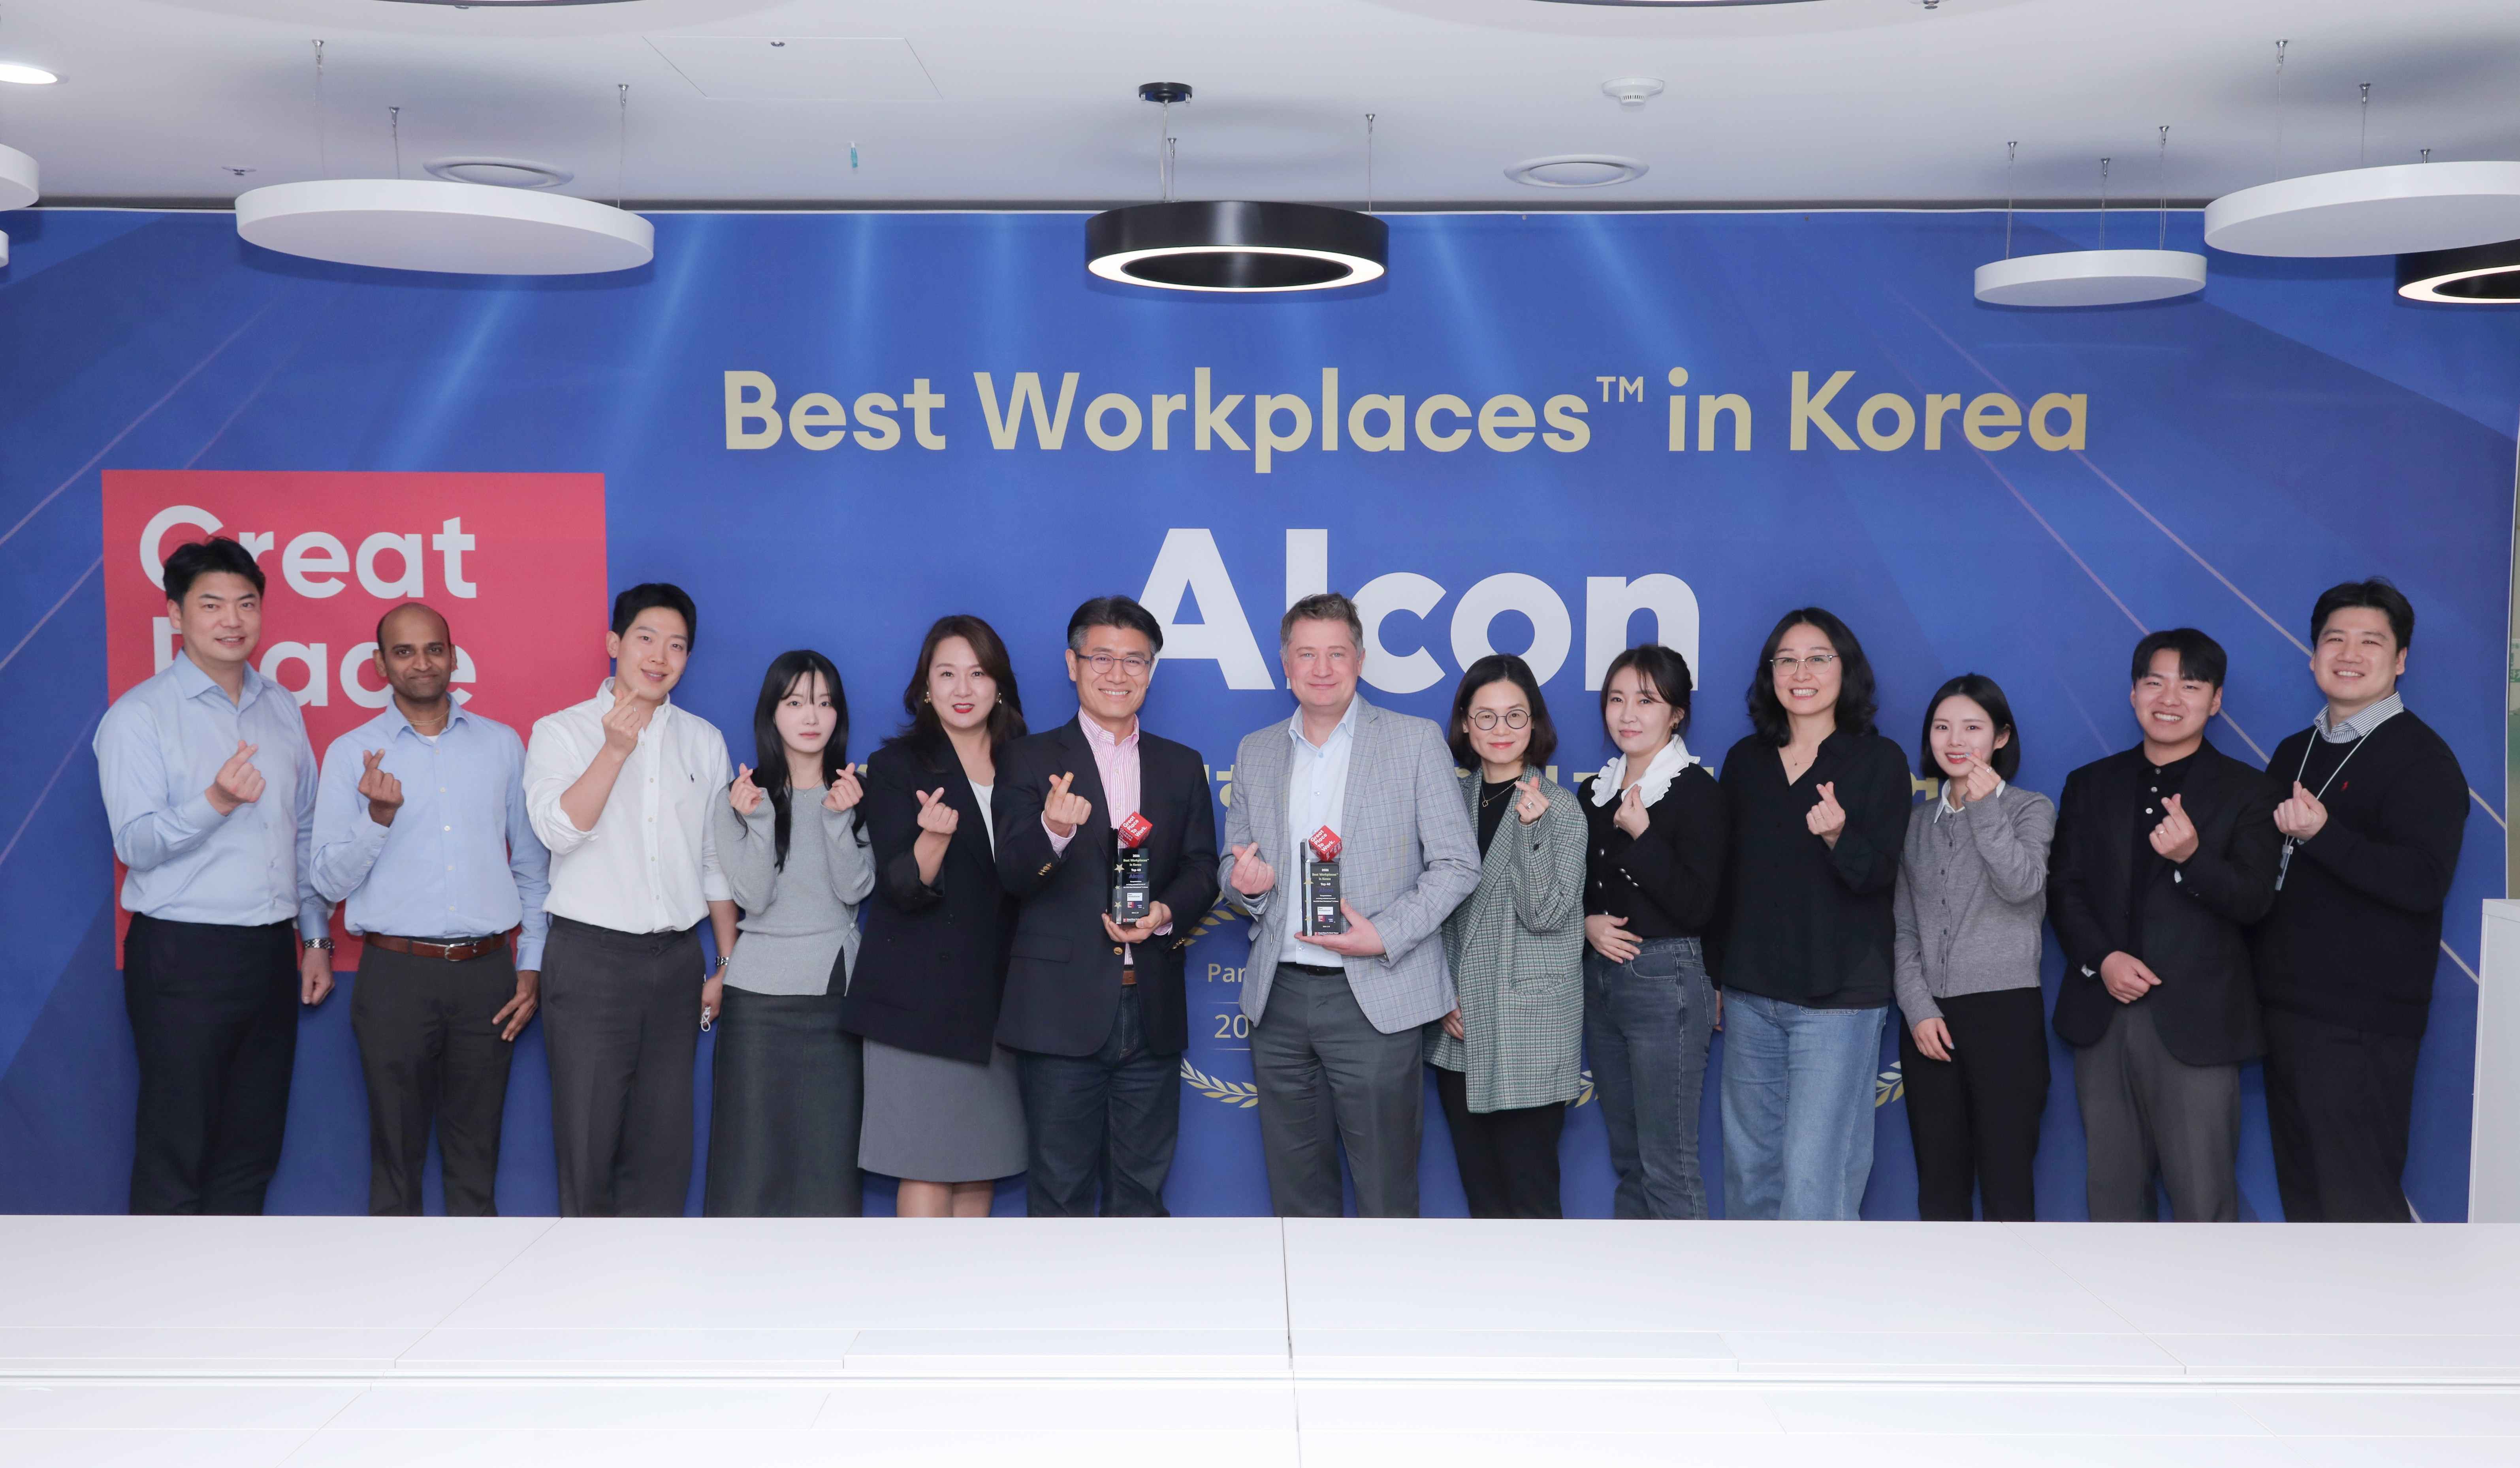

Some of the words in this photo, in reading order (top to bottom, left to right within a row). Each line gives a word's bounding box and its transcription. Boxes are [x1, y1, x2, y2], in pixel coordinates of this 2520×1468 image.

[724, 370, 946, 451] Best
[1668, 367, 1752, 452] in
[1790, 370, 2087, 452] Korea
[1123, 816, 1135, 827] Great
[1127, 819, 1139, 831] Place
[1310, 829, 1324, 842] Great
[1314, 833, 1327, 845] Place
